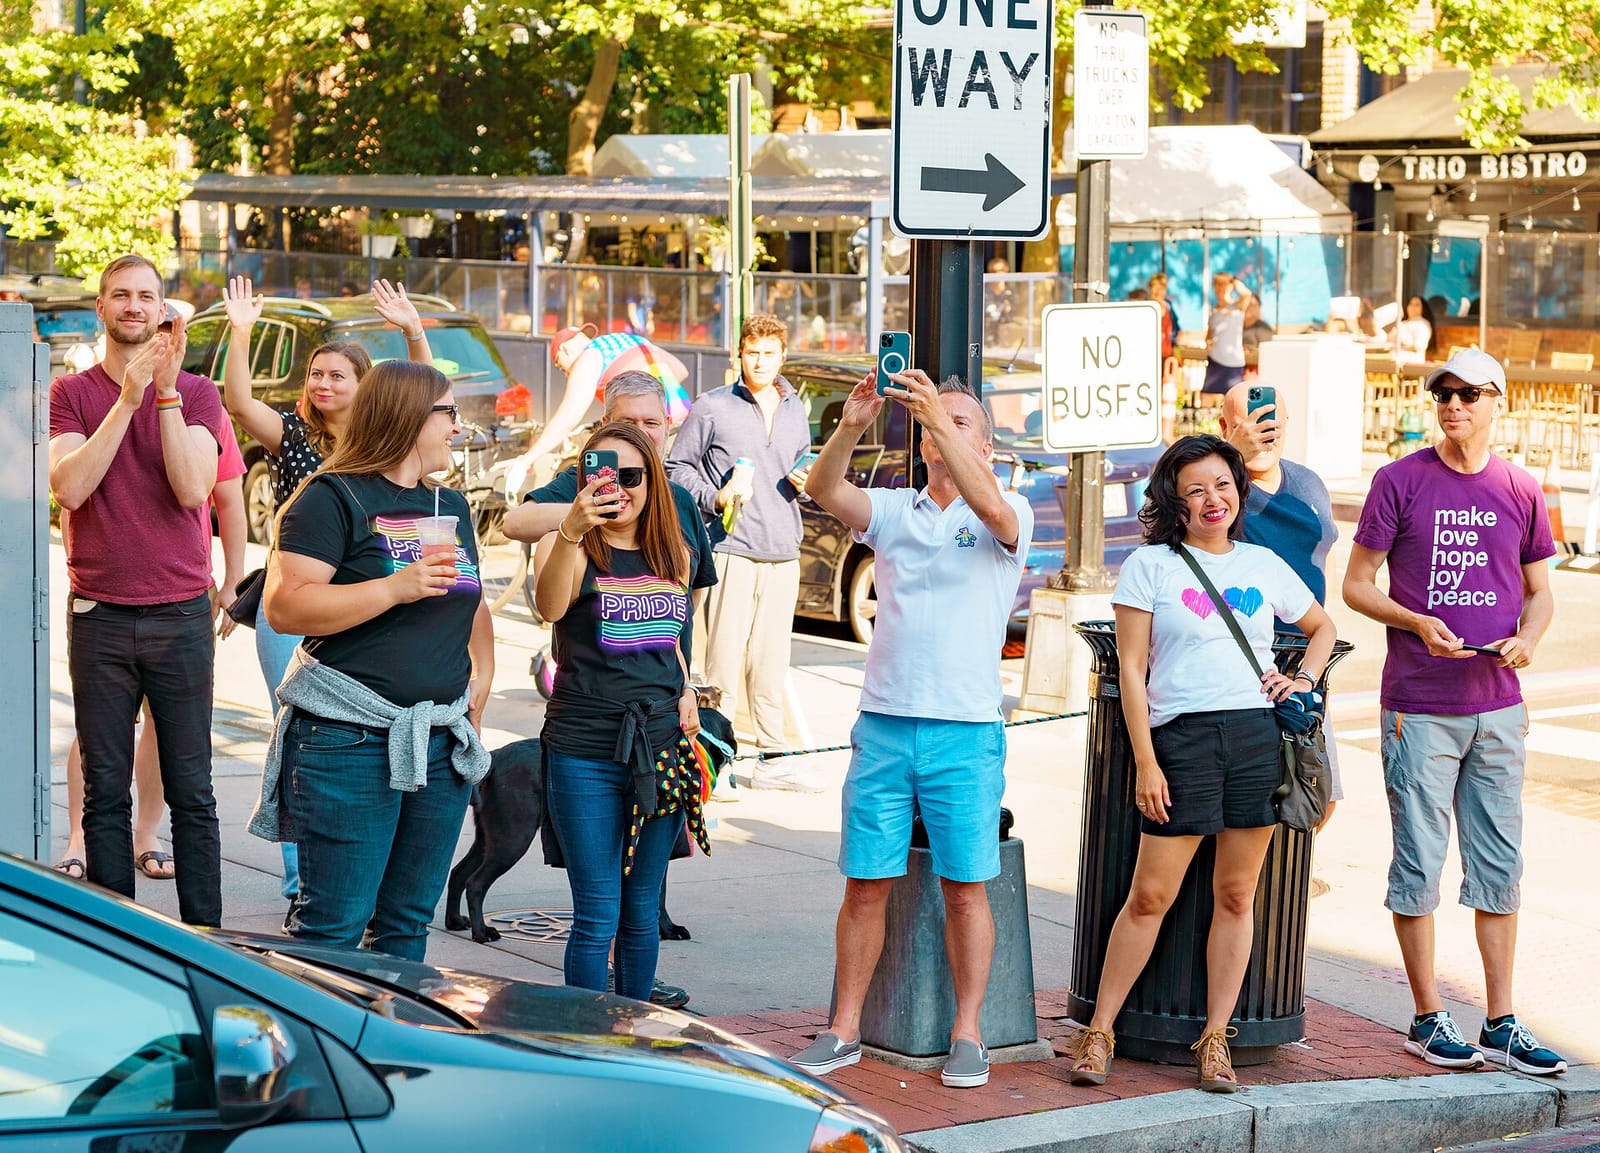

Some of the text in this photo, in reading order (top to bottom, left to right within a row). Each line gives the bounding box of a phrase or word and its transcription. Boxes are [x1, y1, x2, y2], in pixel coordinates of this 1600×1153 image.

[1100, 22, 1119, 39] NO
[1094, 45, 1126, 62] THRU
[908, 47, 1040, 110] WAY
[1085, 66, 1138, 83] TRUCKS
[1402, 151, 1587, 180] TRIO BISTRO
[1082, 335, 1122, 369] NO
[1435, 506, 1498, 527] make
[1434, 525, 1479, 546] love
[1432, 546, 1488, 570] hope
[1427, 566, 1466, 590] joy
[602, 593, 687, 621] PRIDE
[1427, 590, 1497, 609] peace
